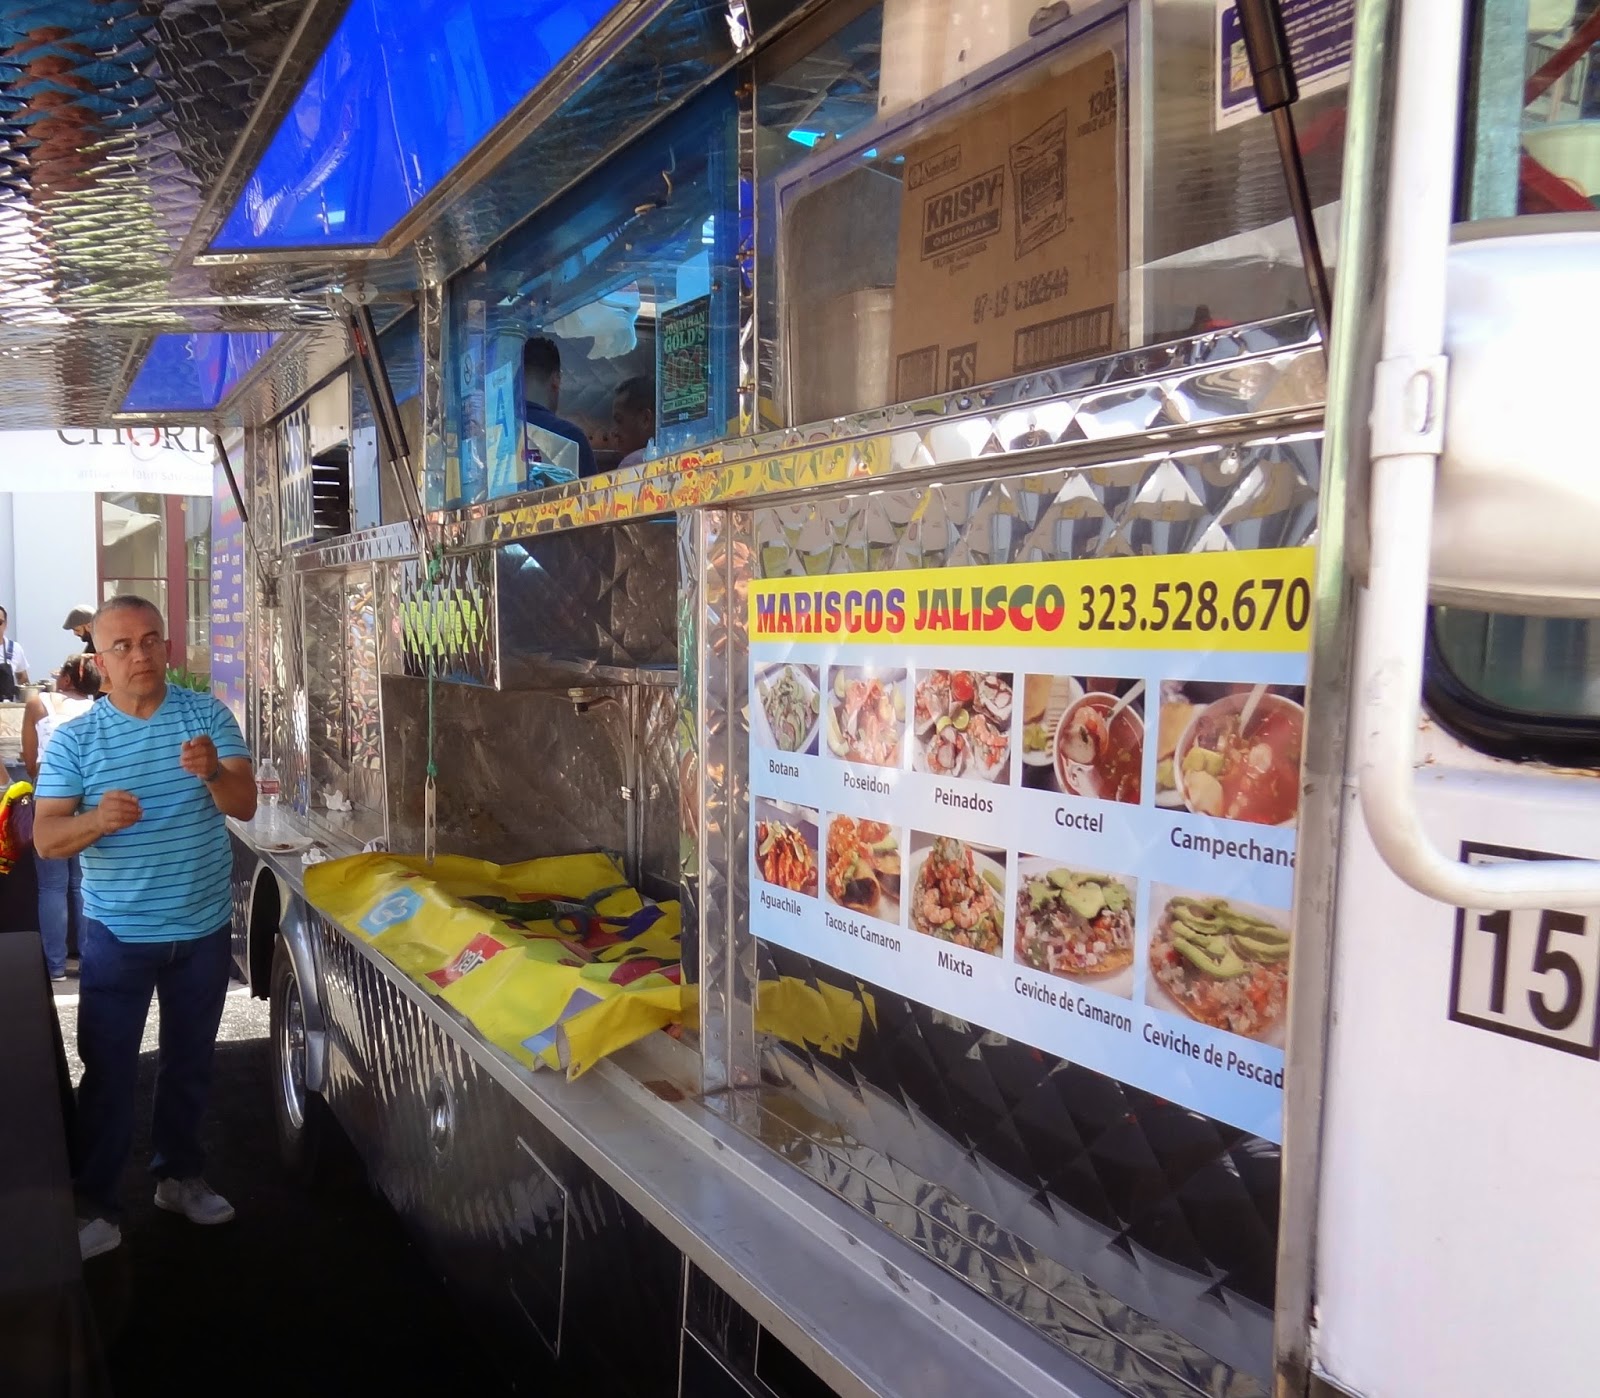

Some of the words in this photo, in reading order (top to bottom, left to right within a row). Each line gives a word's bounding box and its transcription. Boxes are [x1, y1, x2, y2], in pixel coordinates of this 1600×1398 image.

[926, 173, 999, 232] KRISPY
[932, 219, 992, 247] ORIGINAL
[664, 310, 706, 337] JONATHAN
[663, 324, 706, 354] GOLD'S
[756, 588, 906, 634] MARISCOS
[913, 584, 1065, 632] JALISCO
[1077, 577, 1311, 632] 323.528.670
[769, 759, 800, 778] Botana
[843, 771, 890, 795] Poseidon
[934, 787, 993, 813] Peinados
[1054, 807, 1103, 833] Coctel
[760, 890, 802, 917] Aguachile
[824, 911, 848, 933] Tacos
[848, 920, 859, 938] de
[860, 924, 901, 953] Camaron
[937, 950, 973, 978] Mixta
[1477, 909, 1588, 1031] 15
[1014, 976, 1057, 1007] Ceviche
[1059, 991, 1074, 1013] de
[1076, 997, 1132, 1033] Camaron
[1143, 1023, 1201, 1060] Ceviche
[1203, 1043, 1223, 1068] de
